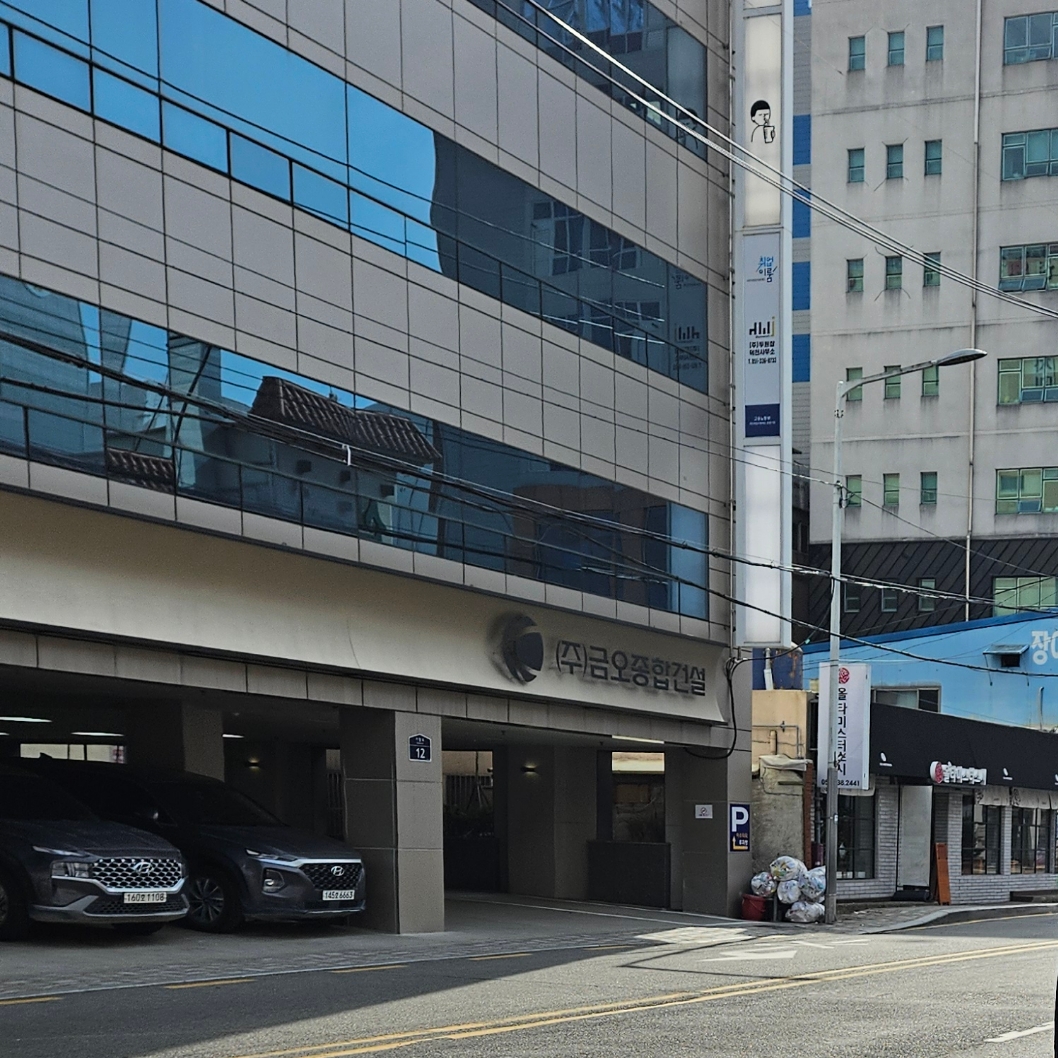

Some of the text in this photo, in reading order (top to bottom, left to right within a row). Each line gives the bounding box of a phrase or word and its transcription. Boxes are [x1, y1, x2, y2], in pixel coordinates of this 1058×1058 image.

[556, 640, 706, 697] (주)금오종합건설
[415, 747, 426, 759] 12
[732, 806, 748, 832] P
